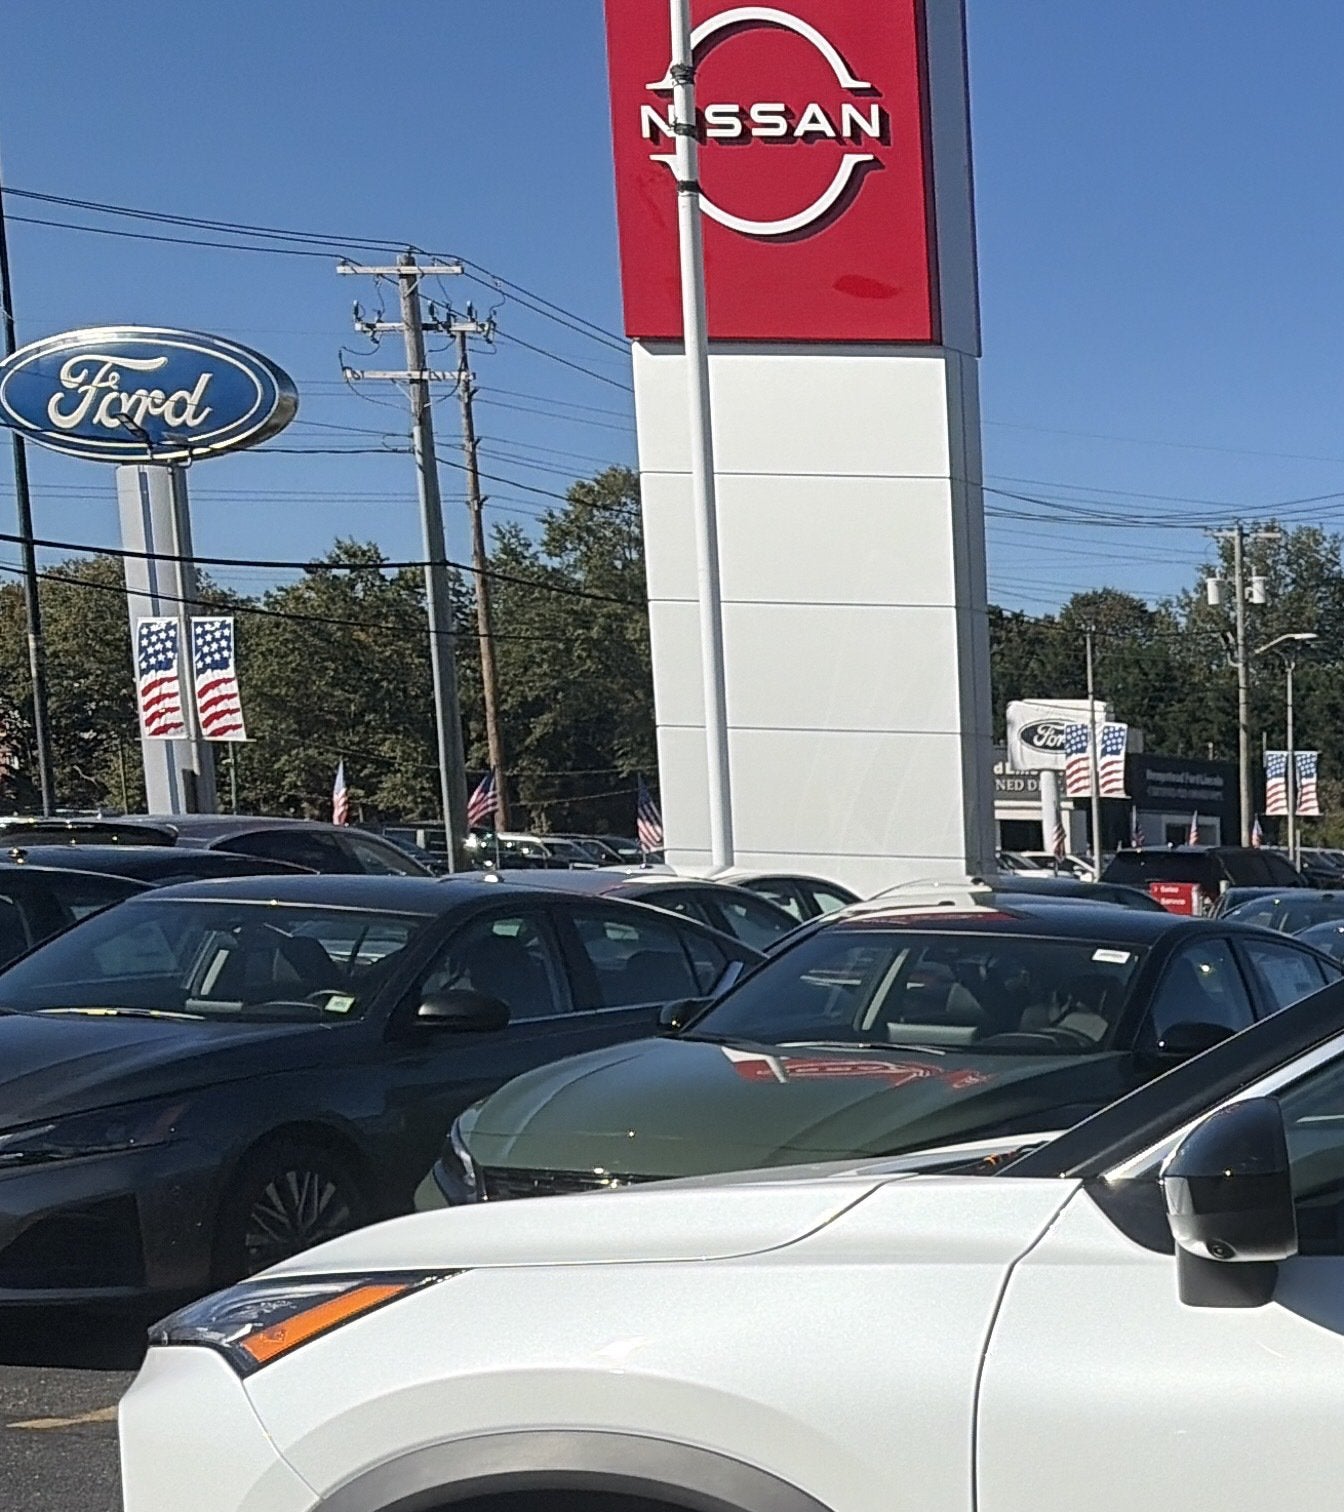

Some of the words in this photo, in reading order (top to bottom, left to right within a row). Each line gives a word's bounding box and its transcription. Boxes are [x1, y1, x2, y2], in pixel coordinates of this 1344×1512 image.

[640, 103, 881, 138] NSSAN
[47, 354, 213, 429] Ford
[1033, 722, 1066, 747] For
